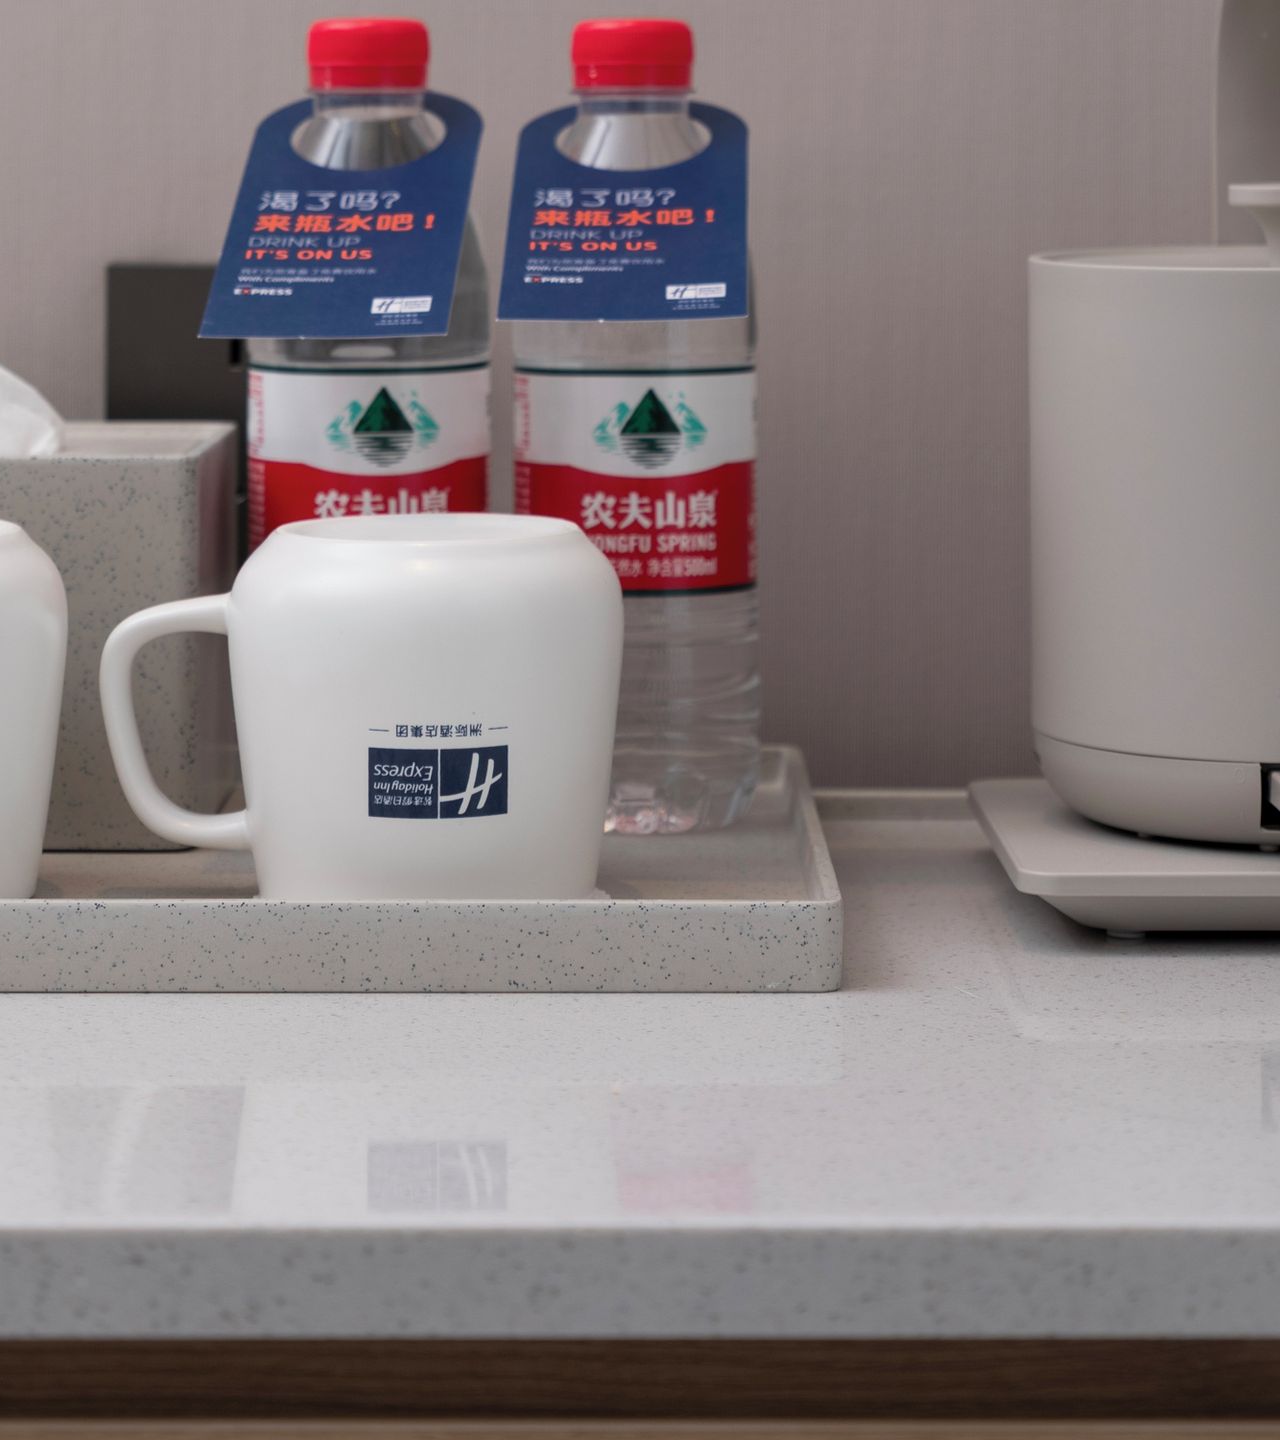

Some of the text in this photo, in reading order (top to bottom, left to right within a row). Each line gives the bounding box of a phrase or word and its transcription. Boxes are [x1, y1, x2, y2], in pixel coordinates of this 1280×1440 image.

[258, 190, 401, 212] 渴了吗?
[533, 188, 676, 208] 渴了吗?
[253, 213, 435, 233] 来瓶水吧！
[532, 208, 716, 227] 来瓶水吧！
[529, 229, 644, 240] DRINK UP
[248, 235, 361, 248] DRINK UP
[528, 240, 658, 251] IT'S ON US
[244, 249, 374, 261] IT'S ON US
[553, 265, 624, 273] Compliments
[264, 276, 335, 284] Compliments
[524, 276, 584, 284] EXPRESS
[233, 288, 293, 296] EXPRESS
[581, 491, 717, 530] 农夫山泉
[657, 532, 717, 553] SPRING
[395, 723, 482, 738] 洲际酒店集团
[374, 762, 433, 781] Express
[374, 781, 433, 794] Holiday Inn
